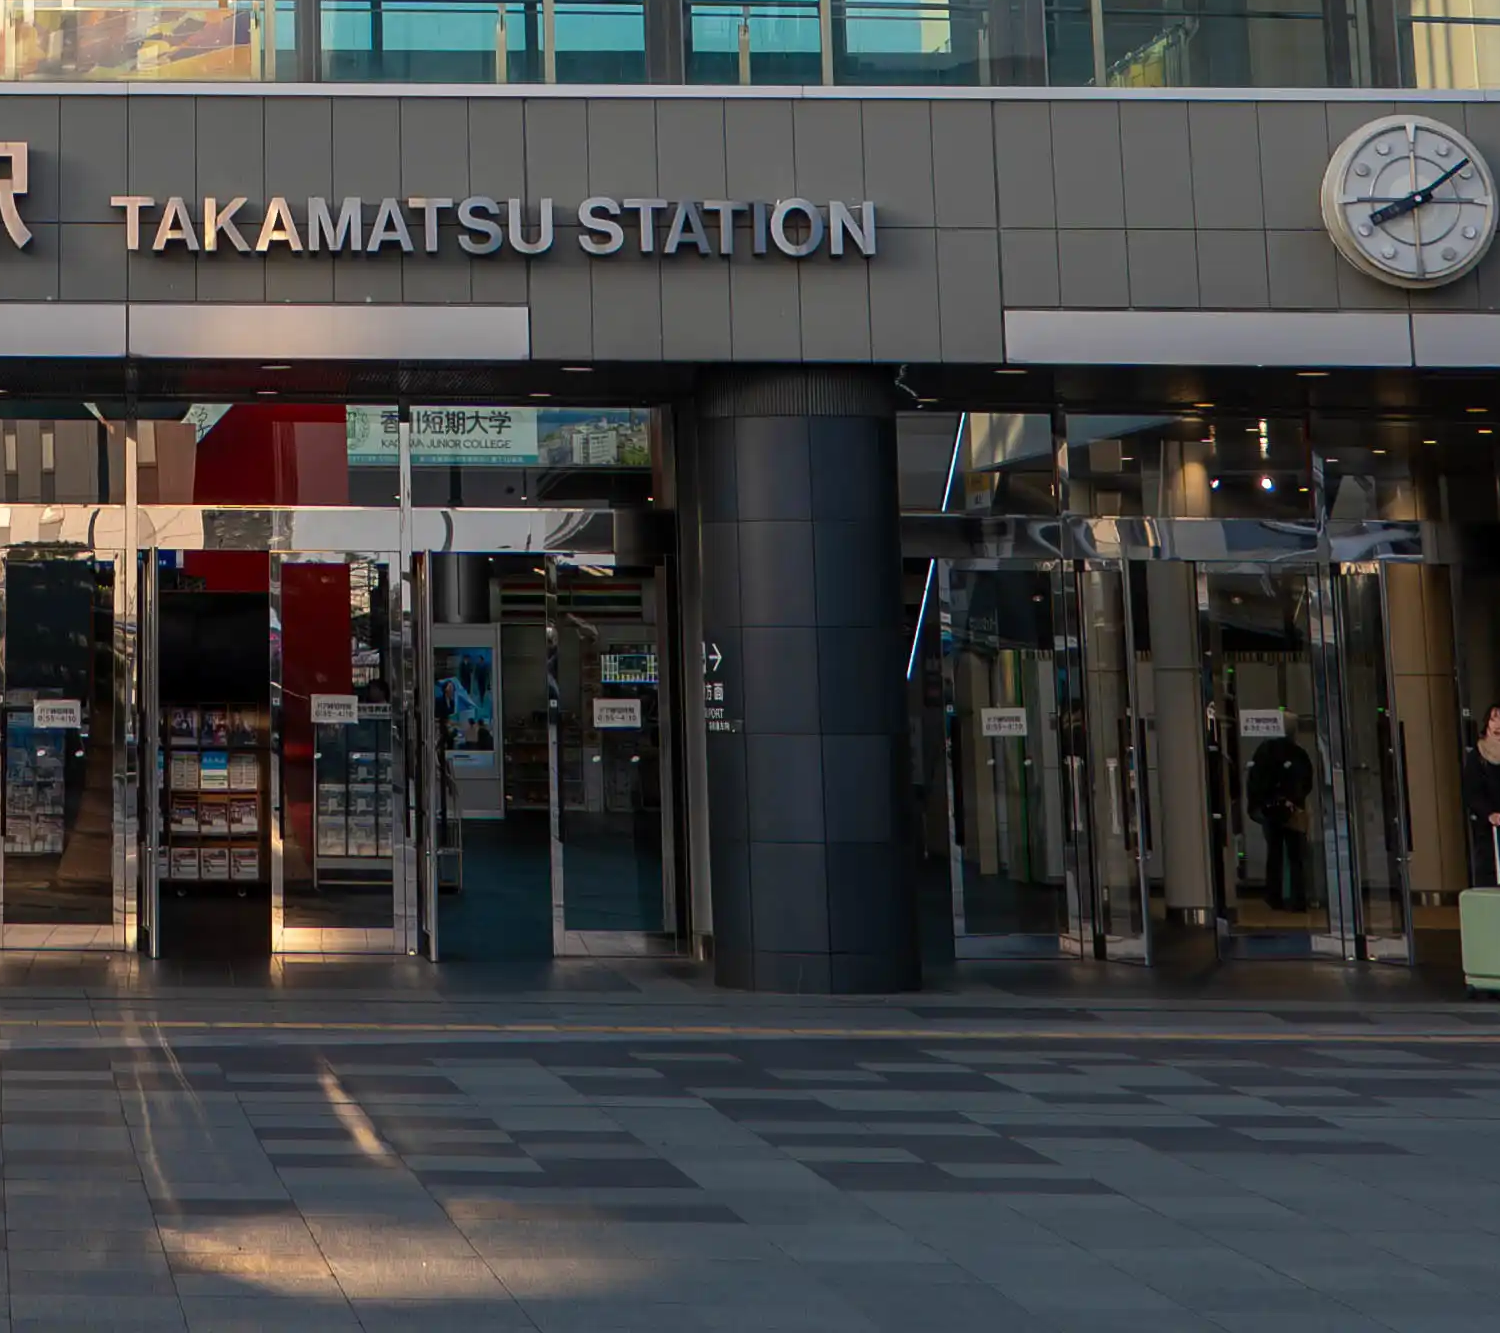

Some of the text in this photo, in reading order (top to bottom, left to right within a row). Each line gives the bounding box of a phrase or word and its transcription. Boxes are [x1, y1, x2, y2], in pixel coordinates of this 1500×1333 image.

[108, 193, 880, 260] TAKAMATSU STATION
[380, 409, 512, 435] 香川短期大学
[381, 439, 512, 449] KAGWA JUNIOR COLLEGE
